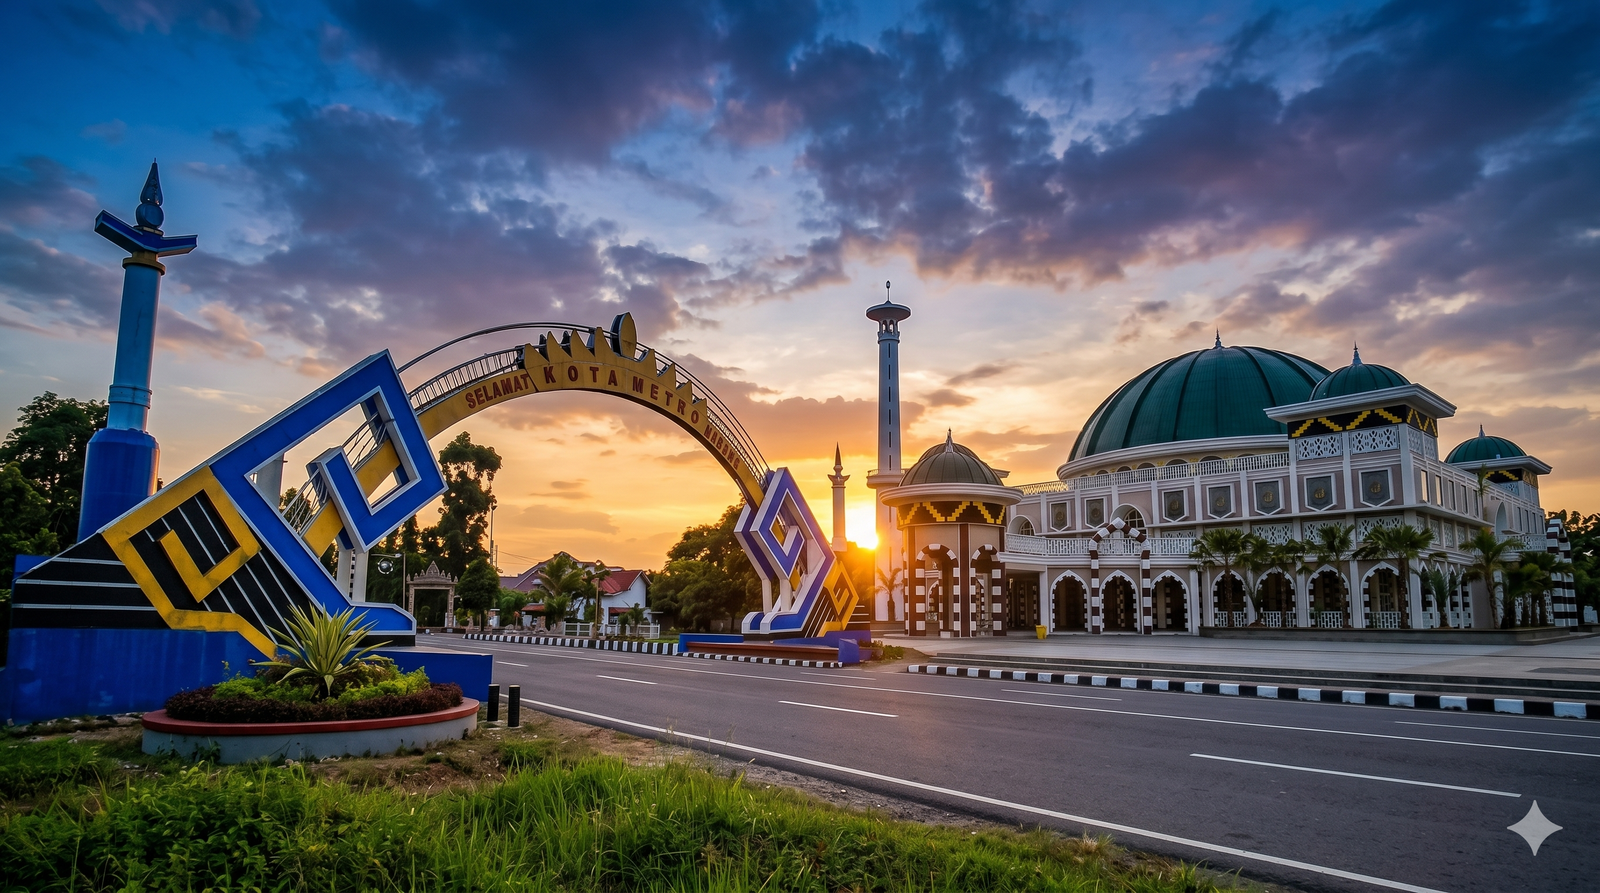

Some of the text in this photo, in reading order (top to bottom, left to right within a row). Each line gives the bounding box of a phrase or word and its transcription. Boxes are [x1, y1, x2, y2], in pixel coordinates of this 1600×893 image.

[465, 373, 529, 409] SELAMAT
[543, 365, 618, 387] KOTA
[632, 376, 699, 424] METRO
